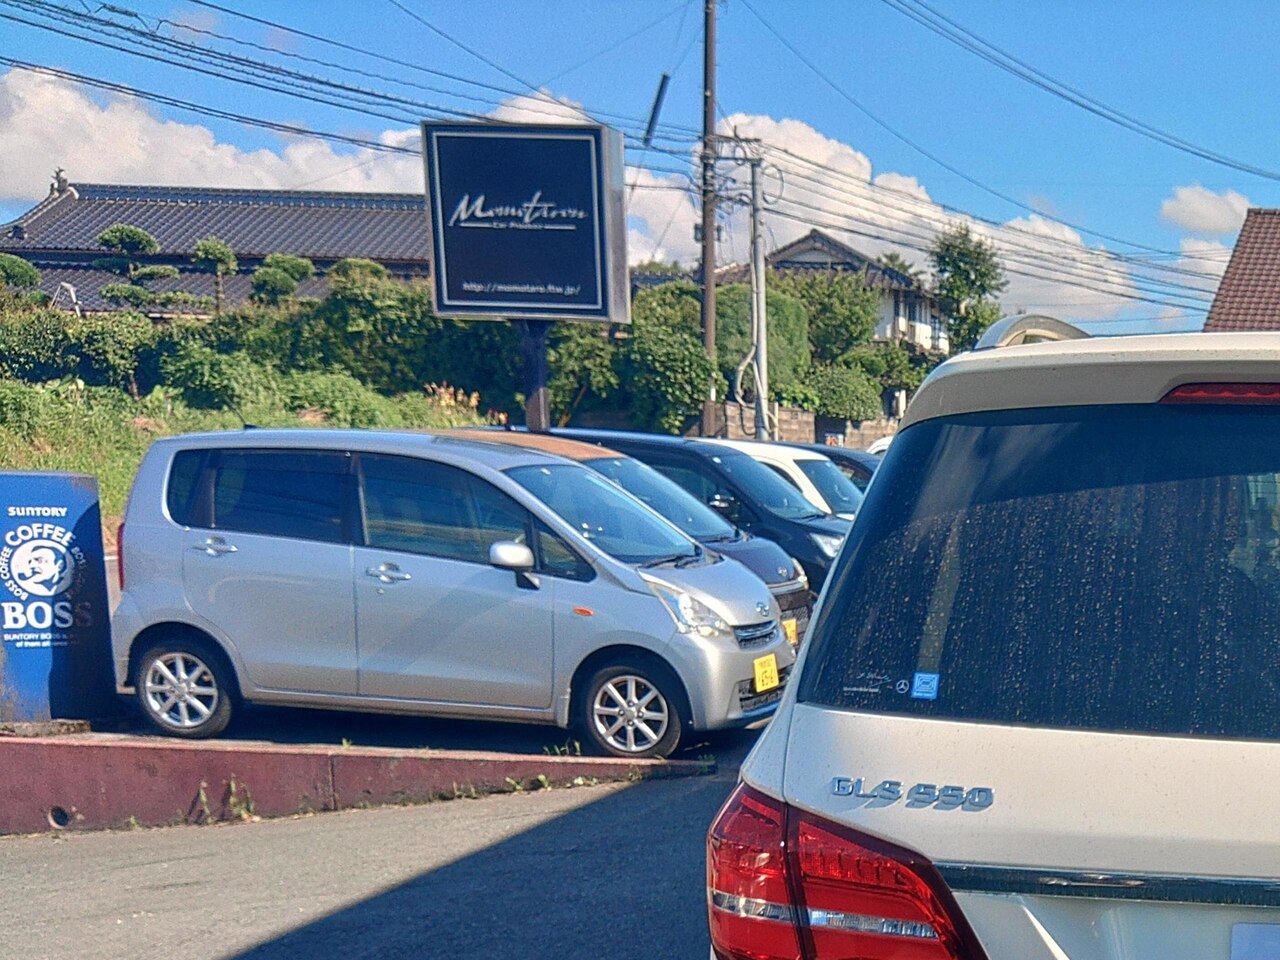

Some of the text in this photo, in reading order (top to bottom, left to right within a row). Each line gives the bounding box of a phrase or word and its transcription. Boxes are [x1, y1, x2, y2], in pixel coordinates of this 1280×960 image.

[7, 506, 68, 517] SUNTORY
[5, 522, 77, 547] COFFEE
[0, 546, 30, 602] BOSS COFFEE
[0, 600, 93, 630] BOSS
[831, 776, 996, 809] GLS 550
